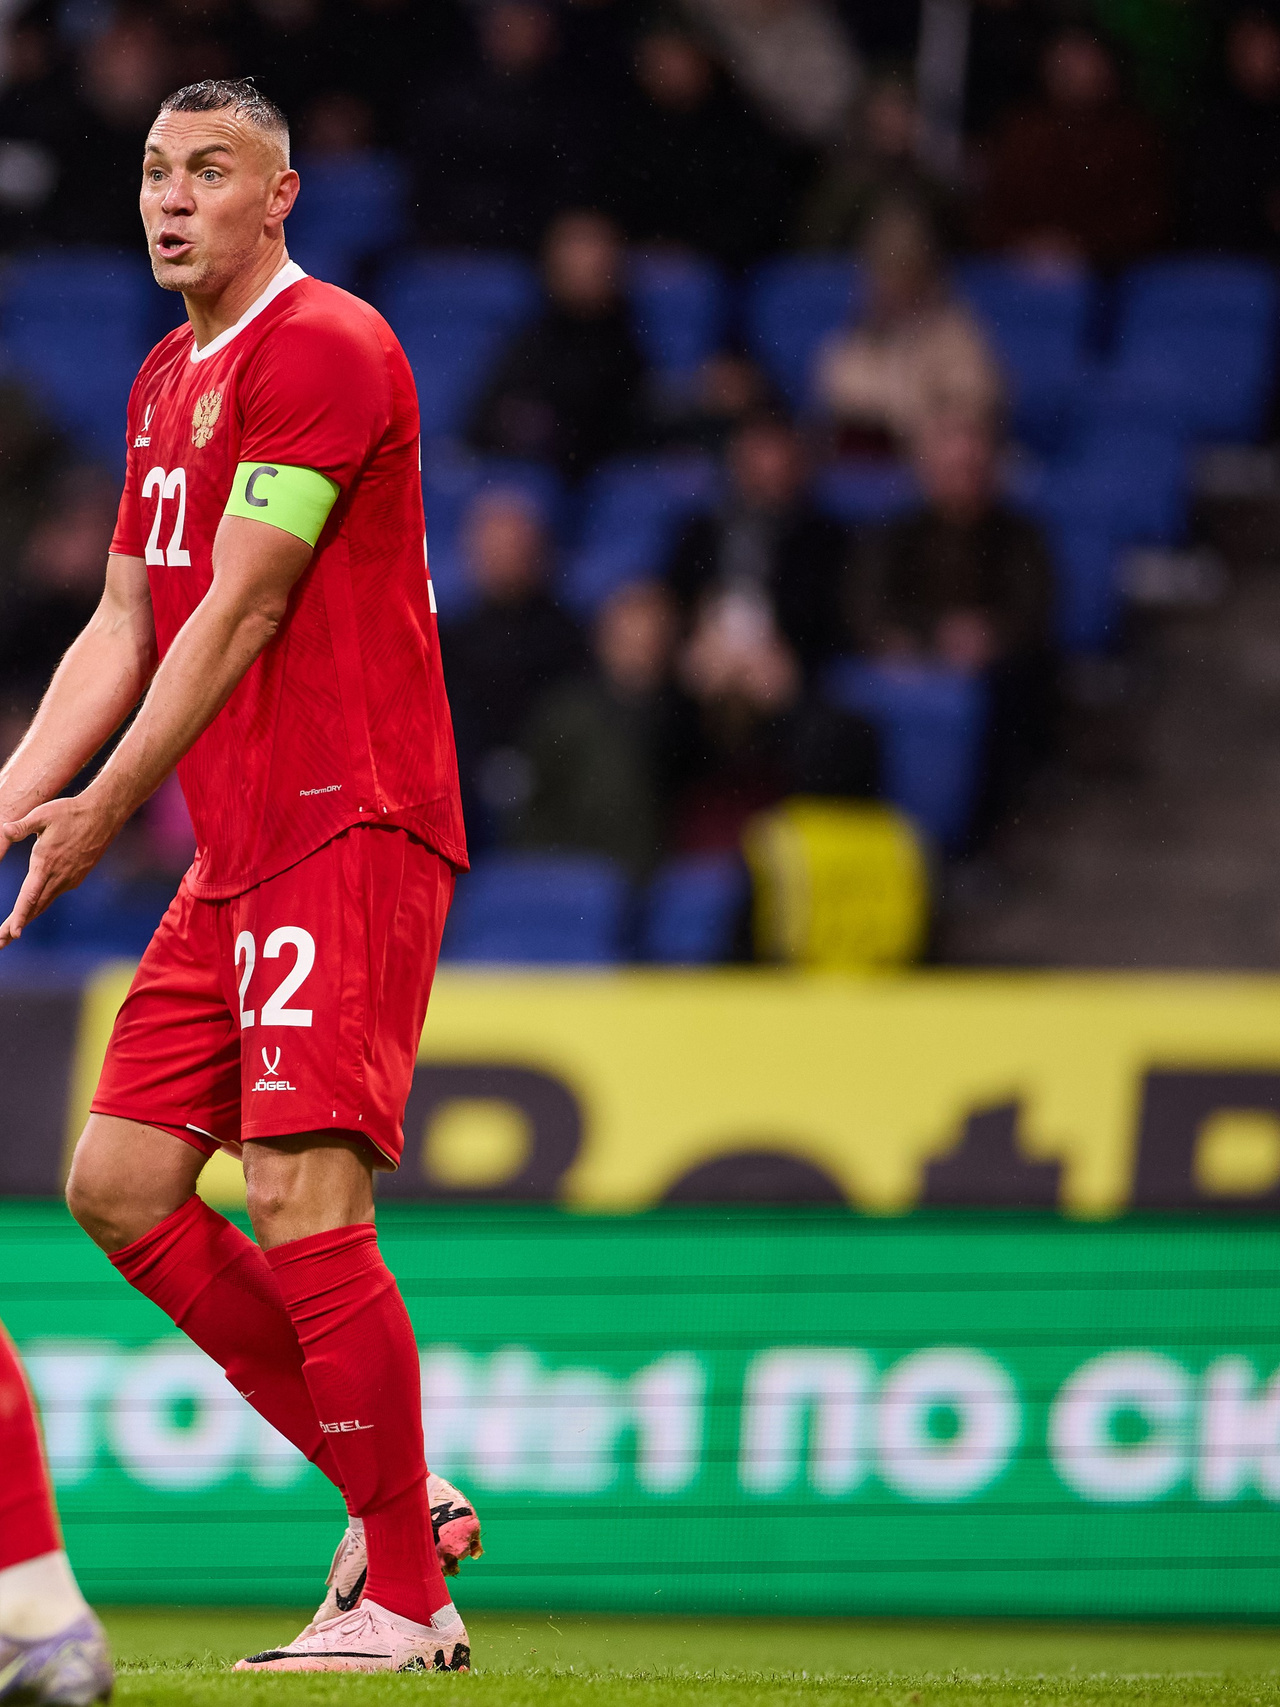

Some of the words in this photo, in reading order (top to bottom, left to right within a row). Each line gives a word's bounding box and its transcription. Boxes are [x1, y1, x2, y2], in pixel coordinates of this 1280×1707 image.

[141, 466, 191, 567] 22
[245, 466, 279, 507] C
[234, 925, 316, 1031] 22
[251, 1078, 297, 1092] JÖGEL
[734, 1344, 1024, 1503] ПО
